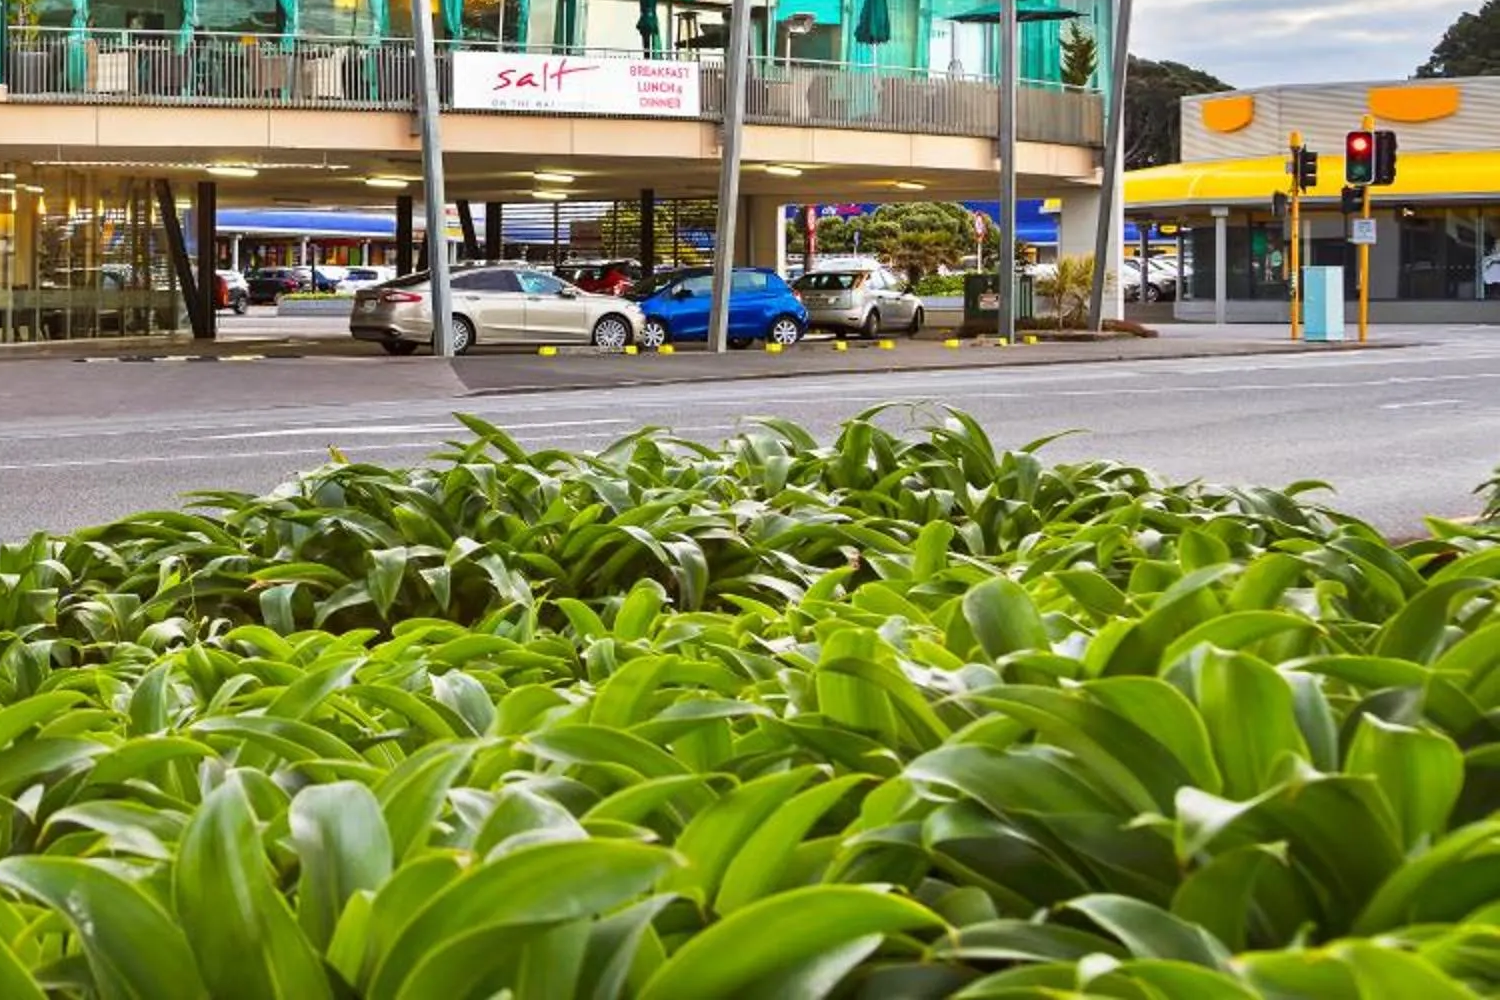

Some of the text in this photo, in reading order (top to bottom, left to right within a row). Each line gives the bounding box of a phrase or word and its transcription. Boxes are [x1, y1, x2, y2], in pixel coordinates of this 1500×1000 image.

[493, 58, 600, 92] salt
[629, 65, 690, 79] BREAKFAST
[637, 81, 675, 93] LUNCH
[639, 97, 681, 109] DINNER
